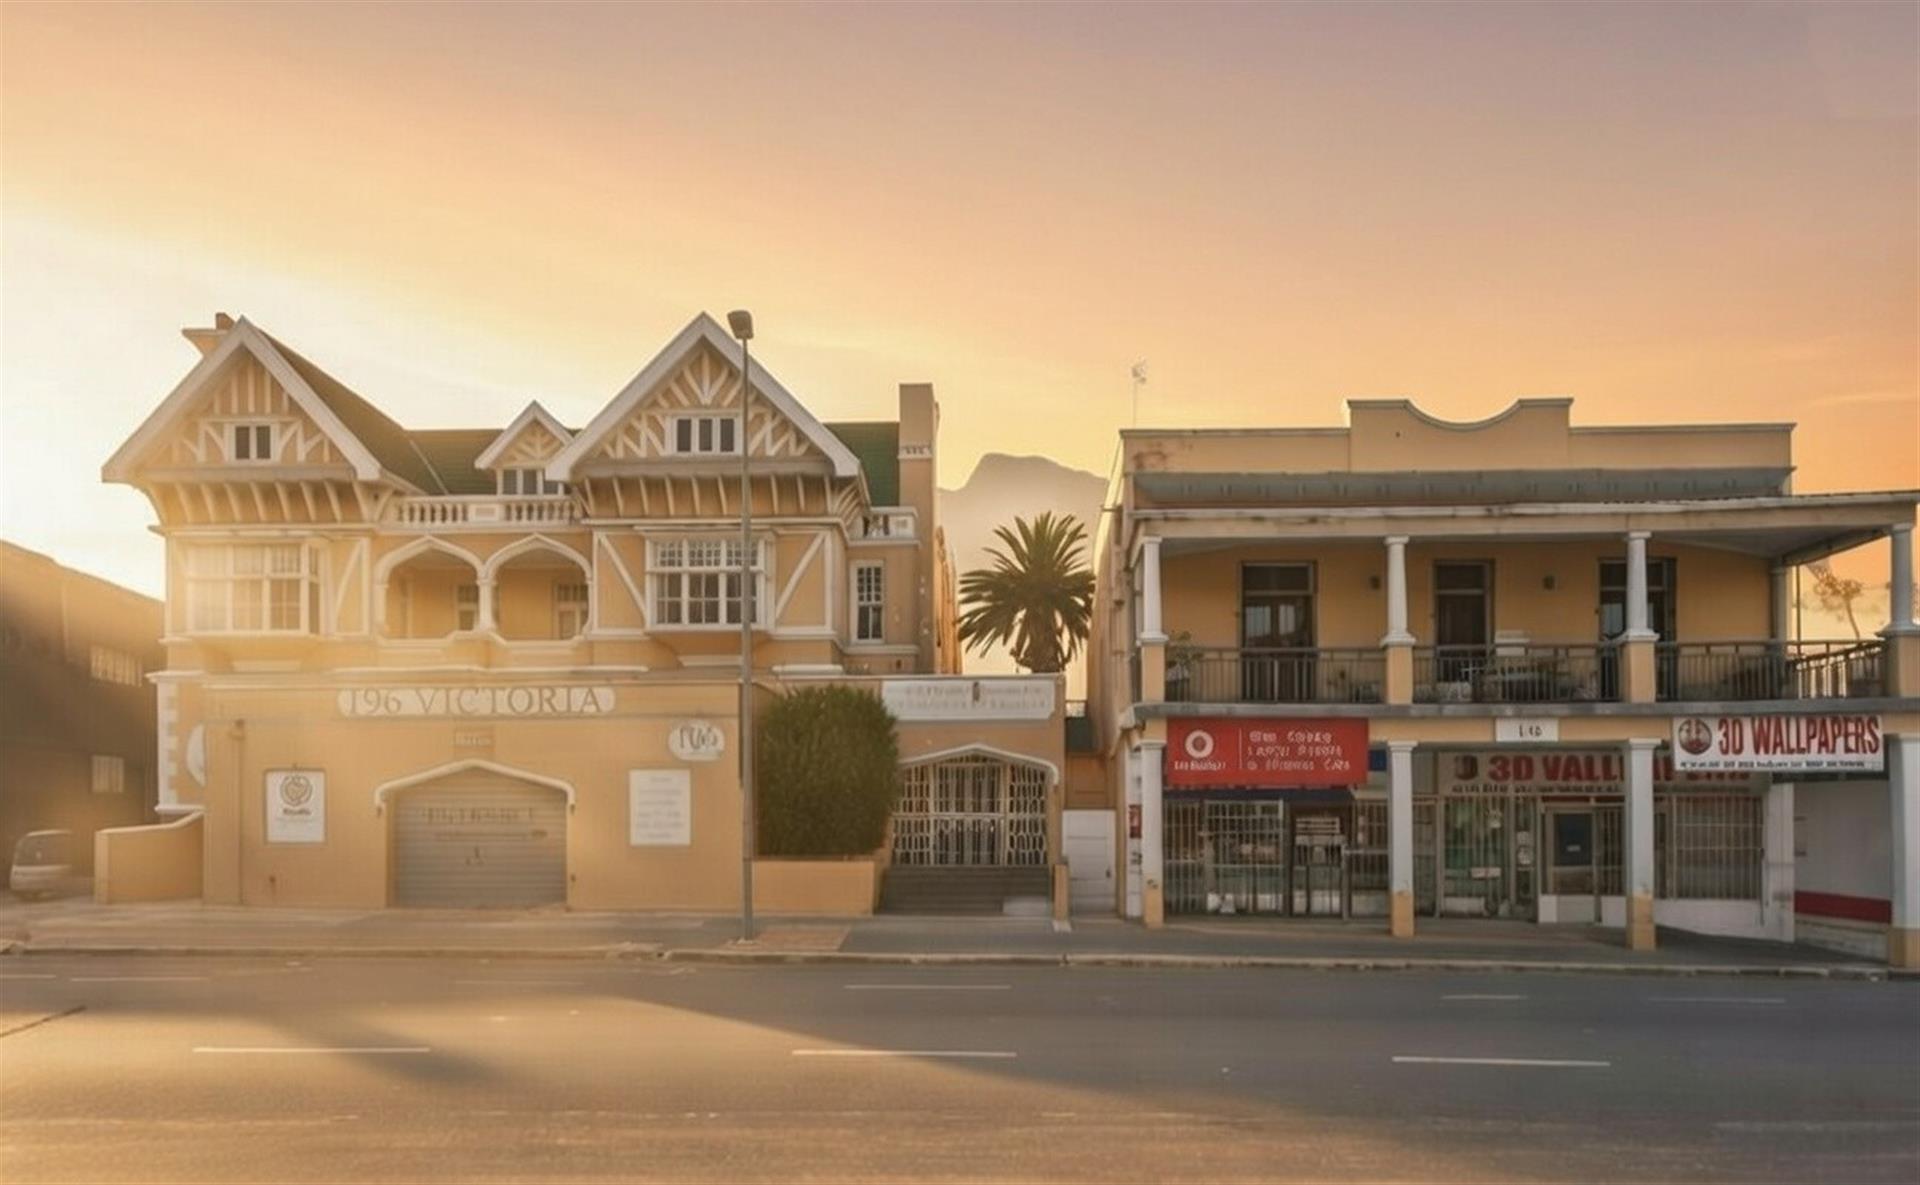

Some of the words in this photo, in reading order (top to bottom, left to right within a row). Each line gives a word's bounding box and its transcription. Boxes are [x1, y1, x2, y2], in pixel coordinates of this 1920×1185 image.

[349, 687, 402, 714] 196
[415, 686, 602, 714] VICTORIA
[1718, 718, 1744, 755] 3D
[1751, 715, 1880, 755] WALLPAPERS
[1488, 755, 1535, 782] 3D
